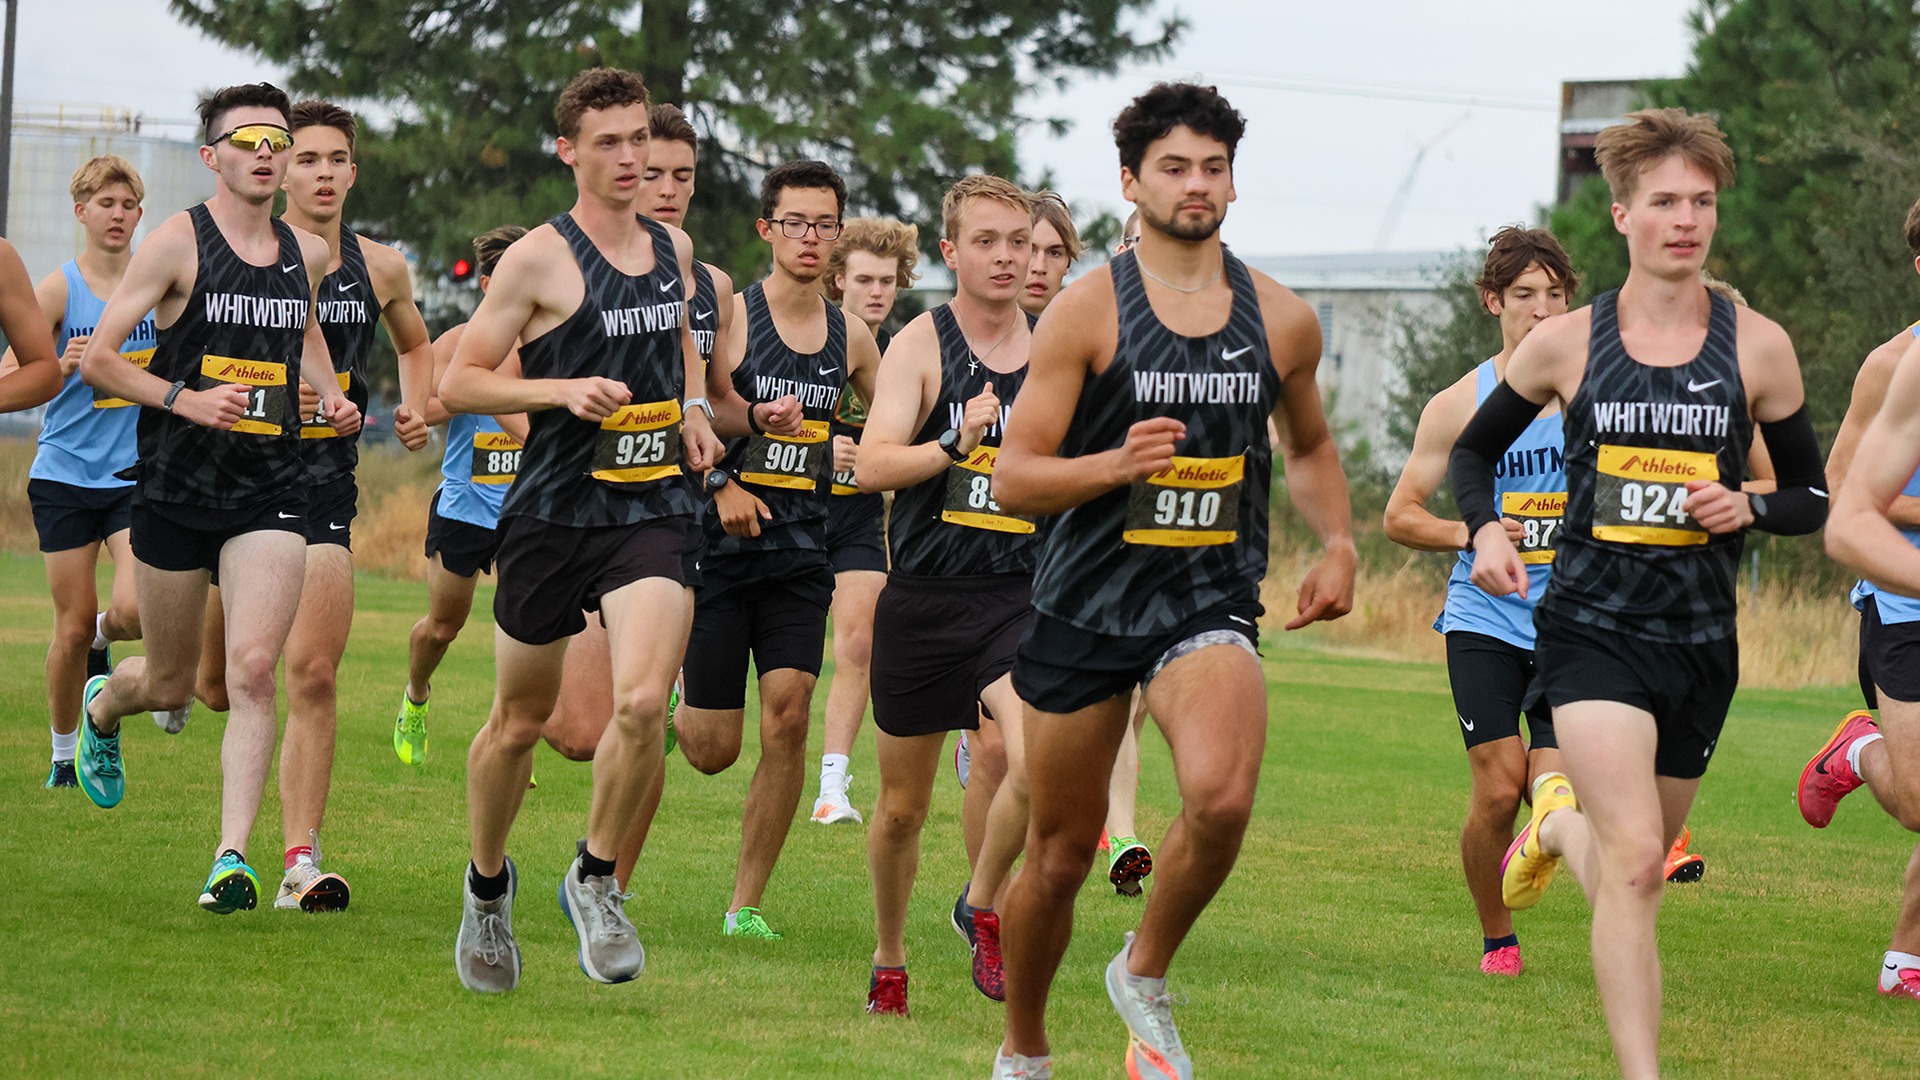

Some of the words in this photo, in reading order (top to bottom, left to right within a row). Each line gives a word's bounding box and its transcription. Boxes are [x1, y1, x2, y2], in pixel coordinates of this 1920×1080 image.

[316, 300, 366, 324] WORTH
[219, 363, 275, 381] Athletic
[756, 375, 841, 411] WHITWORTH
[1133, 371, 1261, 404] WHITWORTH
[618, 410, 672, 426] Athletic
[1594, 401, 1730, 438] WHITWORTH
[615, 431, 667, 465] 925
[765, 442, 809, 473] 901
[1155, 464, 1229, 481] Athletic
[1620, 455, 1697, 477] Athletic
[1154, 489, 1221, 527] 910
[1519, 498, 1567, 511] Athlet
[1620, 482, 1690, 524] 924
[1523, 519, 1563, 548] 87
